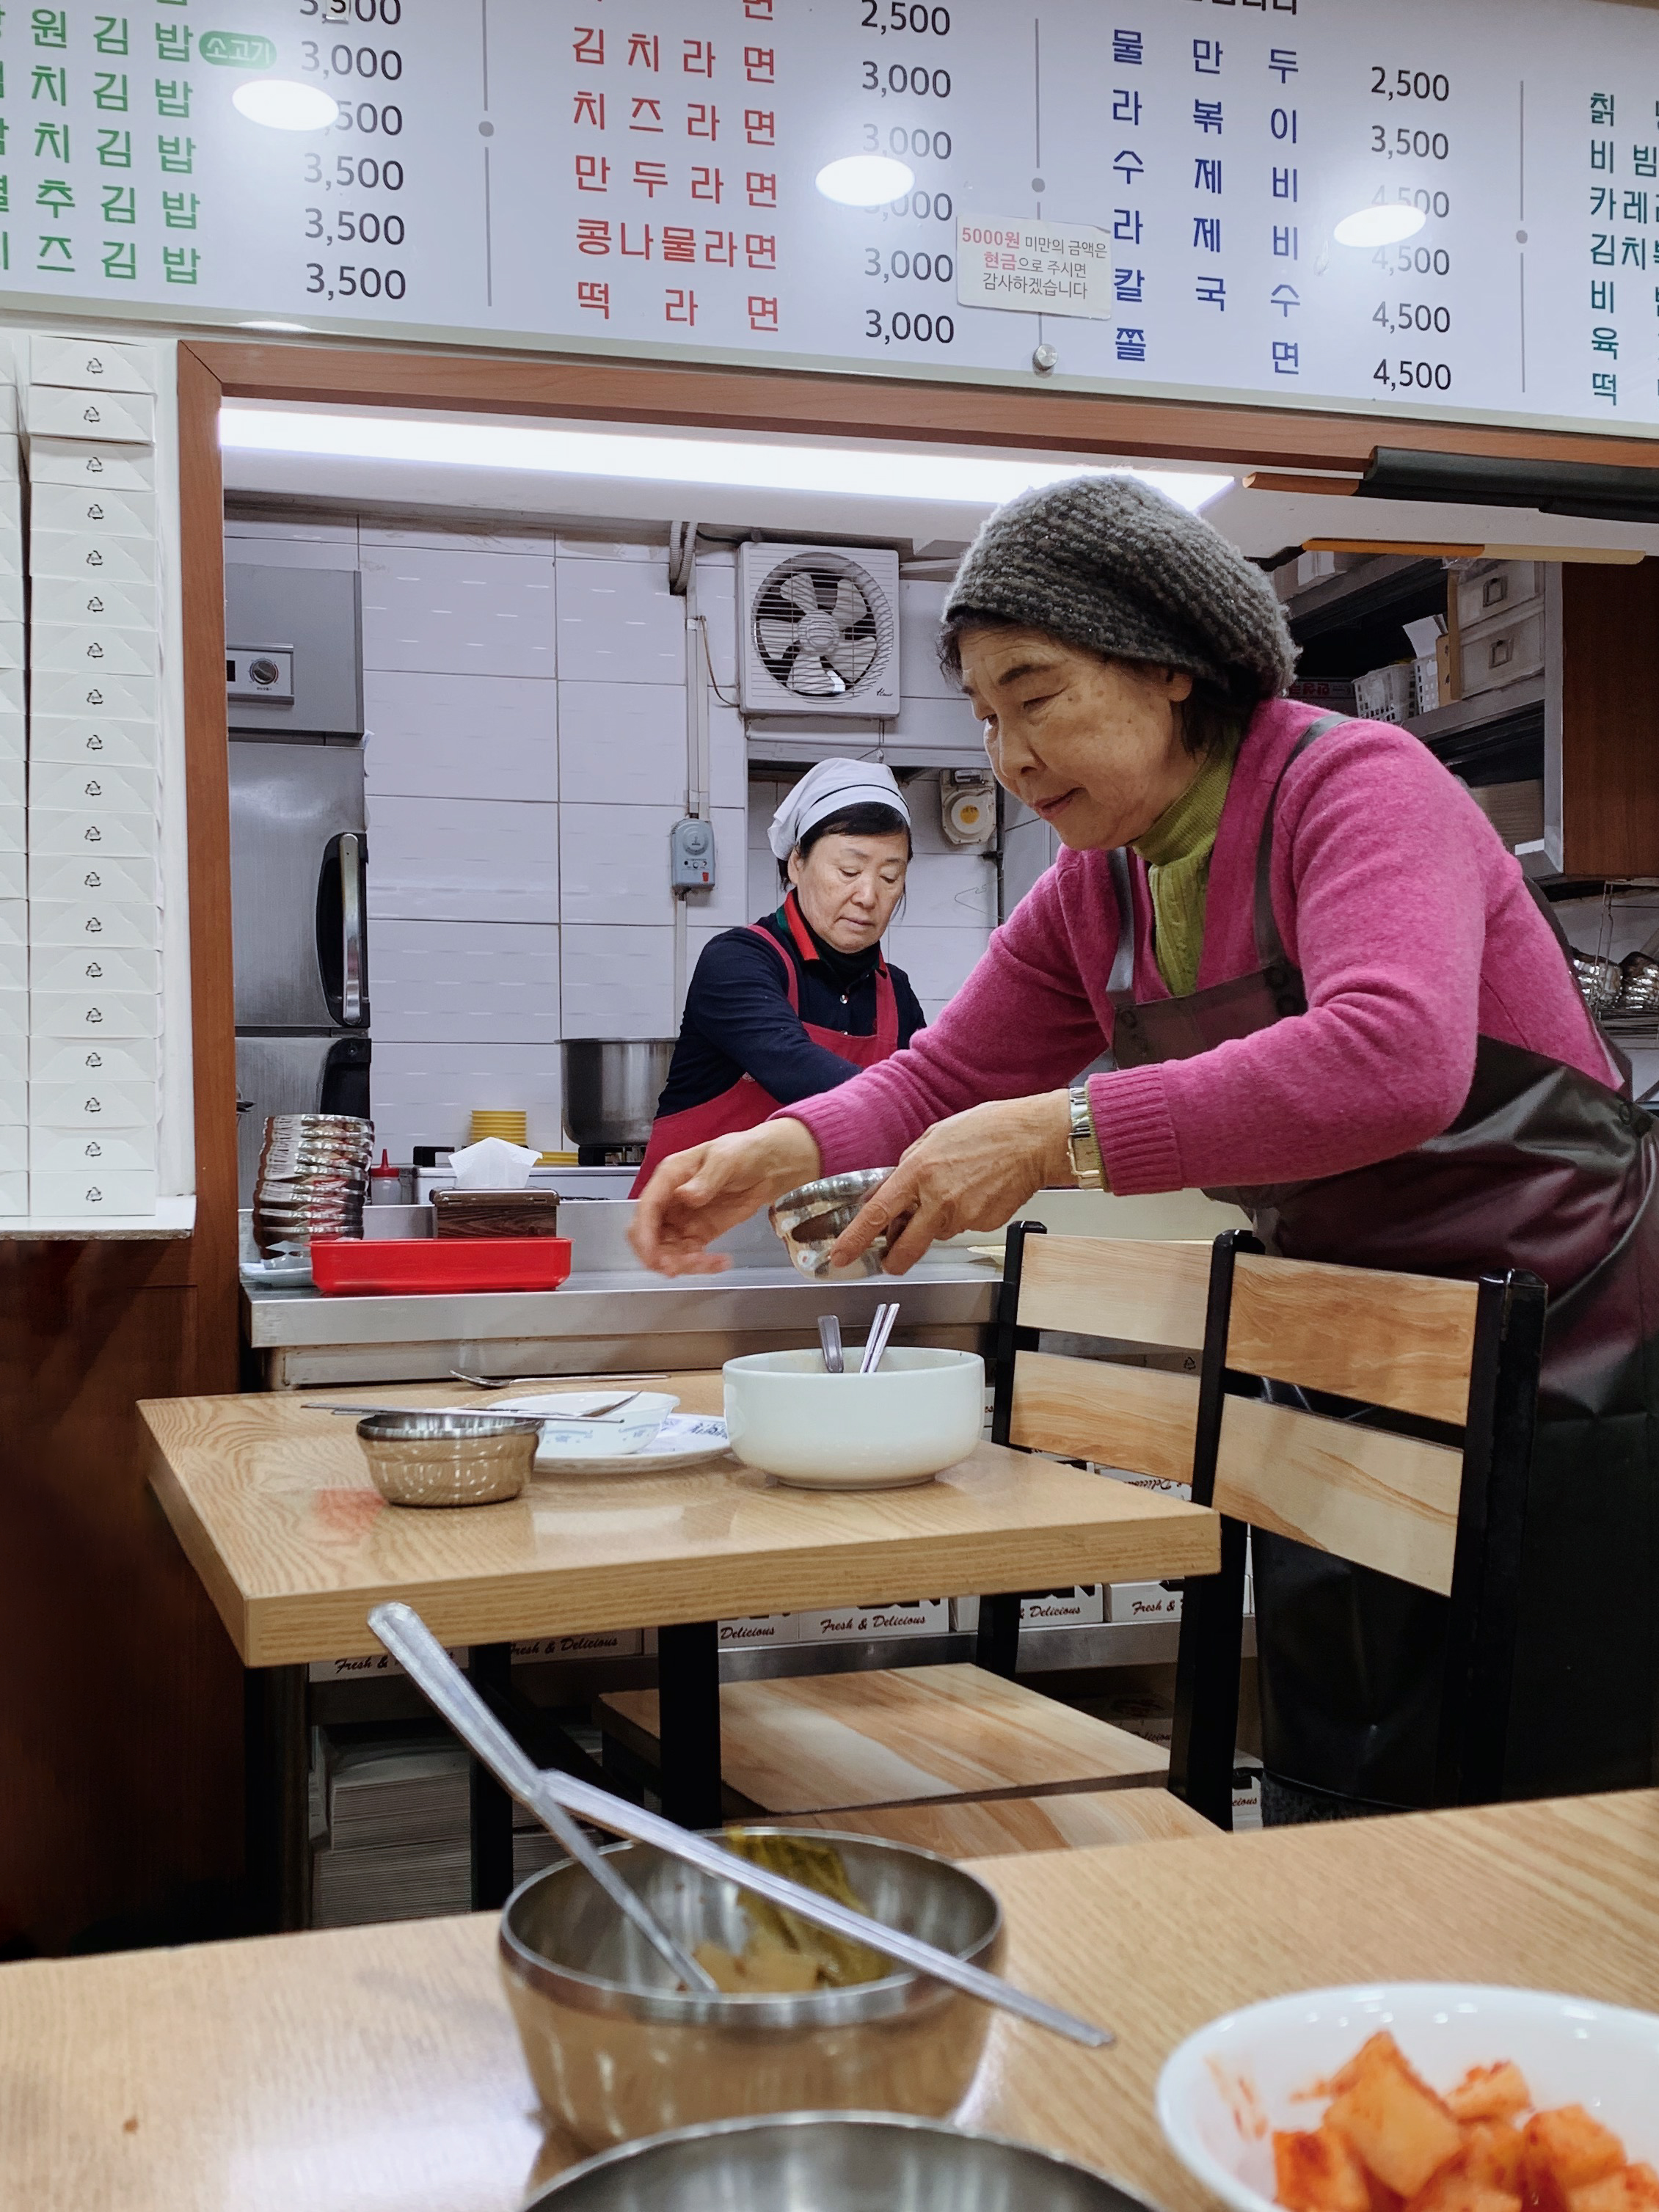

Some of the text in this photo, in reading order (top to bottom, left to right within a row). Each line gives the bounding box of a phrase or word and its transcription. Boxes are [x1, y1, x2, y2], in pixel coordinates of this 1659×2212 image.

[861, 0, 951, 36] 2,500
[205, 37, 269, 64] 소고기
[302, 40, 402, 81] 3,000
[862, 61, 952, 98] 3,000
[1371, 66, 1449, 101] 2,500
[324, 100, 403, 136] ,500
[864, 123, 952, 160] 3,000
[1371, 125, 1449, 160] 3,500
[304, 153, 404, 191] 3,500
[305, 208, 405, 246] 3,500
[962, 227, 1107, 258] 5000원 미만의 금액은
[577, 219, 954, 283] 콩나물라면 3,000
[984, 251, 1086, 278] 현금으로 주시면
[1371, 245, 1450, 276] 4,500
[307, 263, 406, 300] 3,500
[982, 272, 1087, 299] 감사하겠습니다
[866, 309, 954, 344] 3,000
[1372, 301, 1450, 334] 4,500
[1374, 359, 1451, 391] 4,500
[1029, 1605, 1081, 1618] Delicious
[1132, 1598, 1162, 1615] Fresh
[720, 1626, 776, 1640] Delicious
[820, 1614, 926, 1634] Fresh & Delicious
[560, 1637, 619, 1651] Delicious
[335, 1655, 373, 1674] Fresh
[376, 1655, 389, 1668] &
